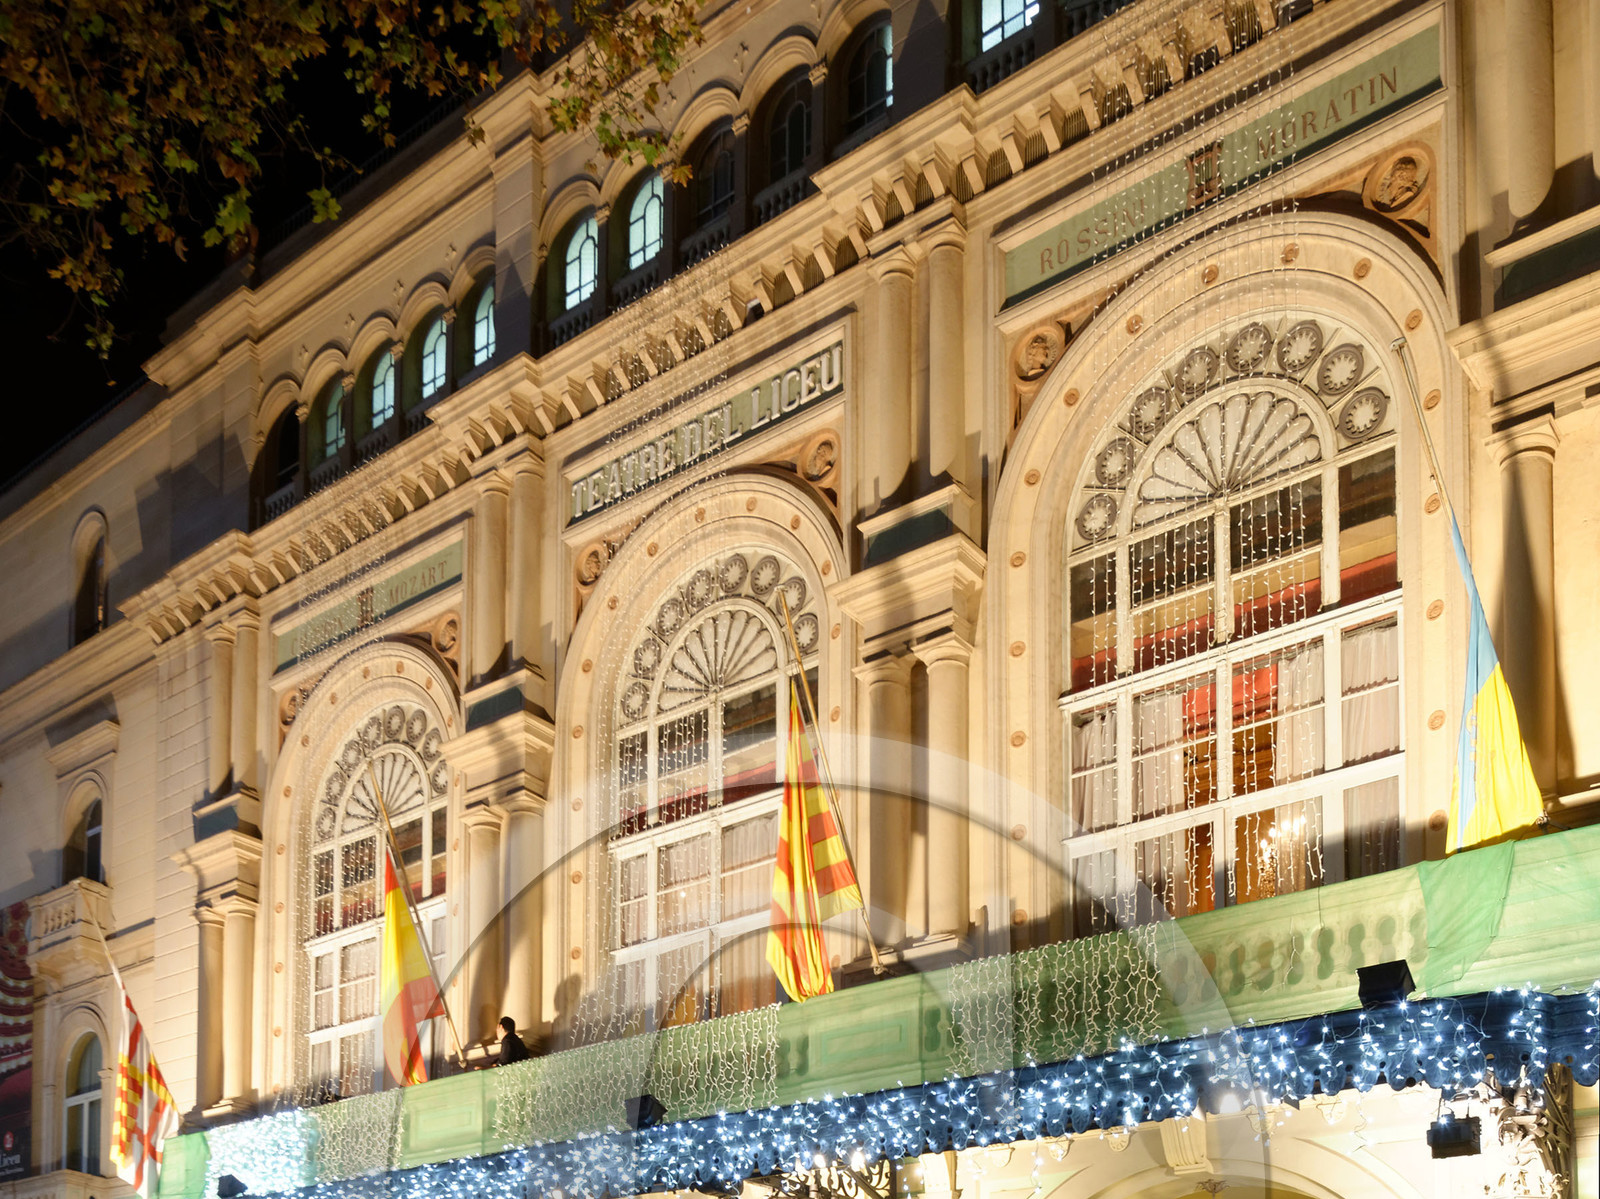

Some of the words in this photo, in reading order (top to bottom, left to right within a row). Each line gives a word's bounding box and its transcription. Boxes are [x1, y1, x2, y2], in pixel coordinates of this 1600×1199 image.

[1039, 198, 1145, 275] ROSSINI
[1256, 66, 1399, 162] MORATIN
[572, 436, 676, 518] TEATRE
[682, 402, 743, 465] DEL
[751, 344, 843, 430] LICEU
[389, 560, 448, 606] MOZART
